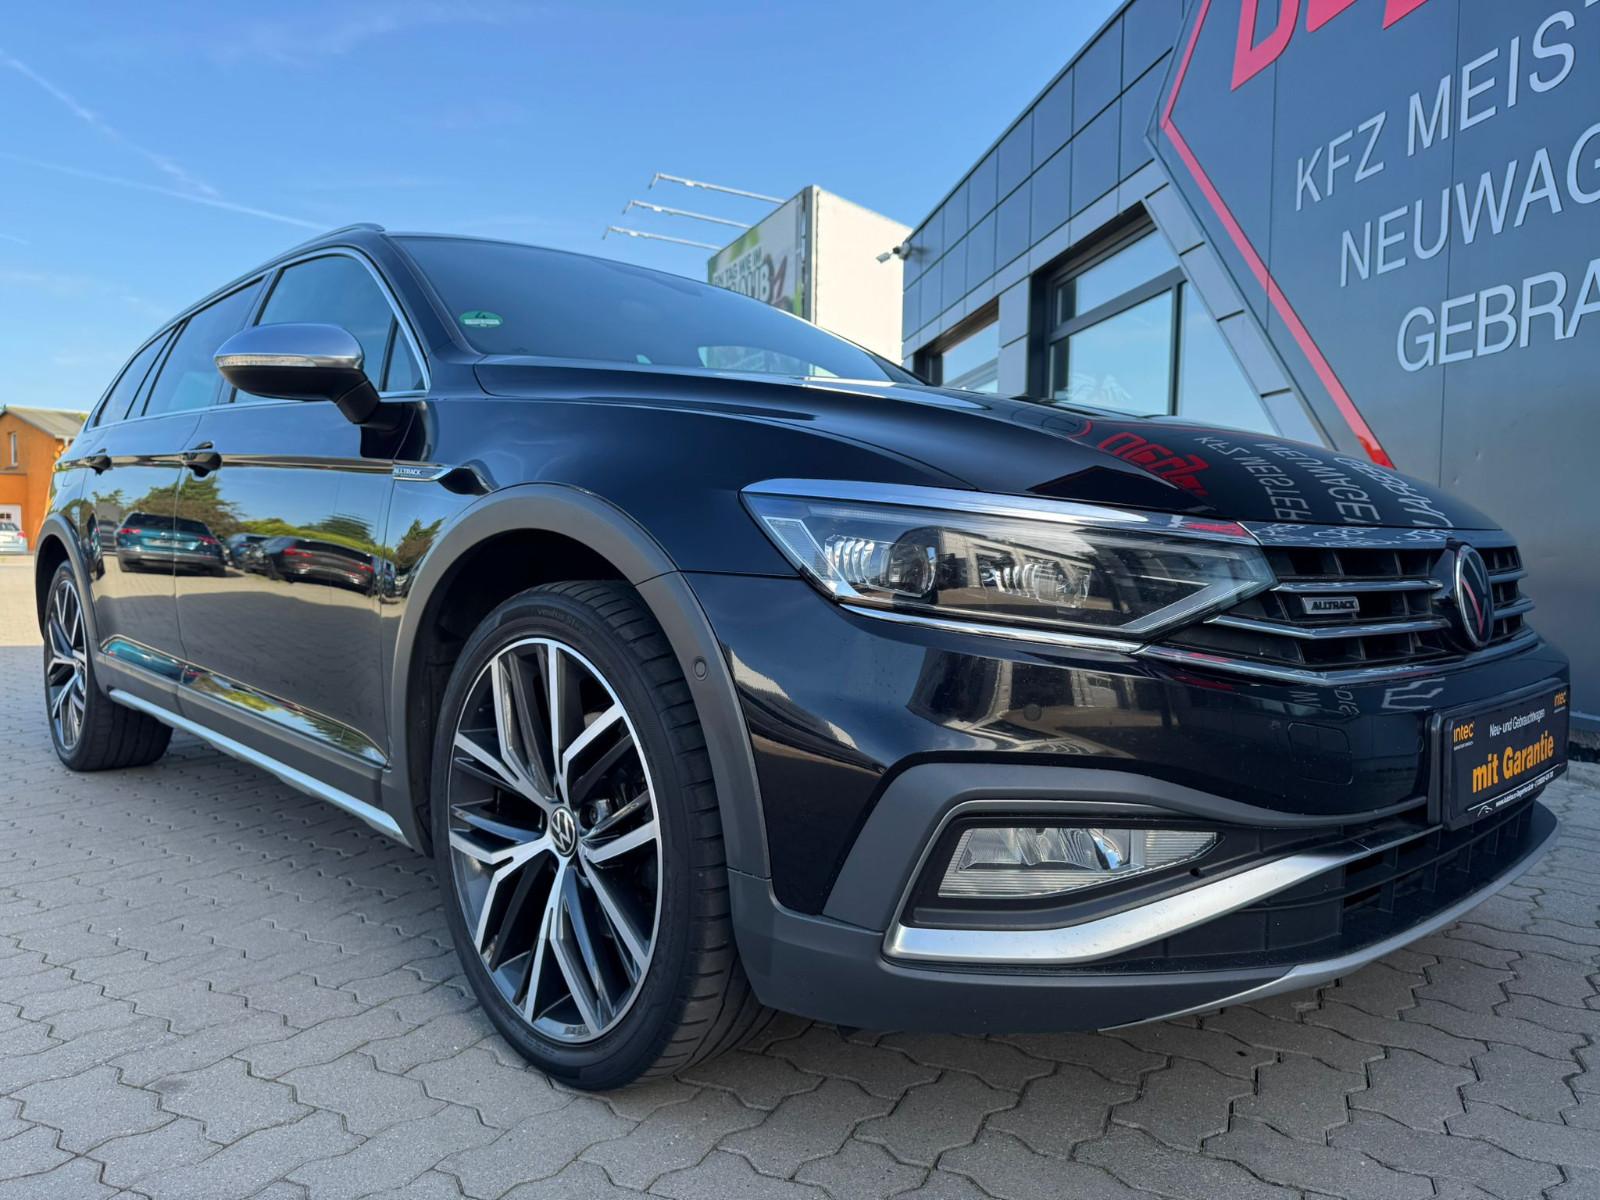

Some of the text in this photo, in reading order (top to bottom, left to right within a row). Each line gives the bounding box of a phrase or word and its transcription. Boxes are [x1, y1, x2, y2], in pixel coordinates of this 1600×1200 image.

[1296, 111, 1387, 211] KFZ
[1407, 0, 1600, 157] MEIS
[1340, 122, 1600, 288] NEUWAG
[1397, 258, 1600, 372] GEBRA
[1311, 600, 1355, 611] ALLTRACK
[1453, 723, 1474, 743] intec
[1490, 723, 1502, 738] Neu-
[1502, 718, 1513, 732] und
[1472, 753, 1499, 793] mit
[1503, 730, 1555, 779] Garantie
